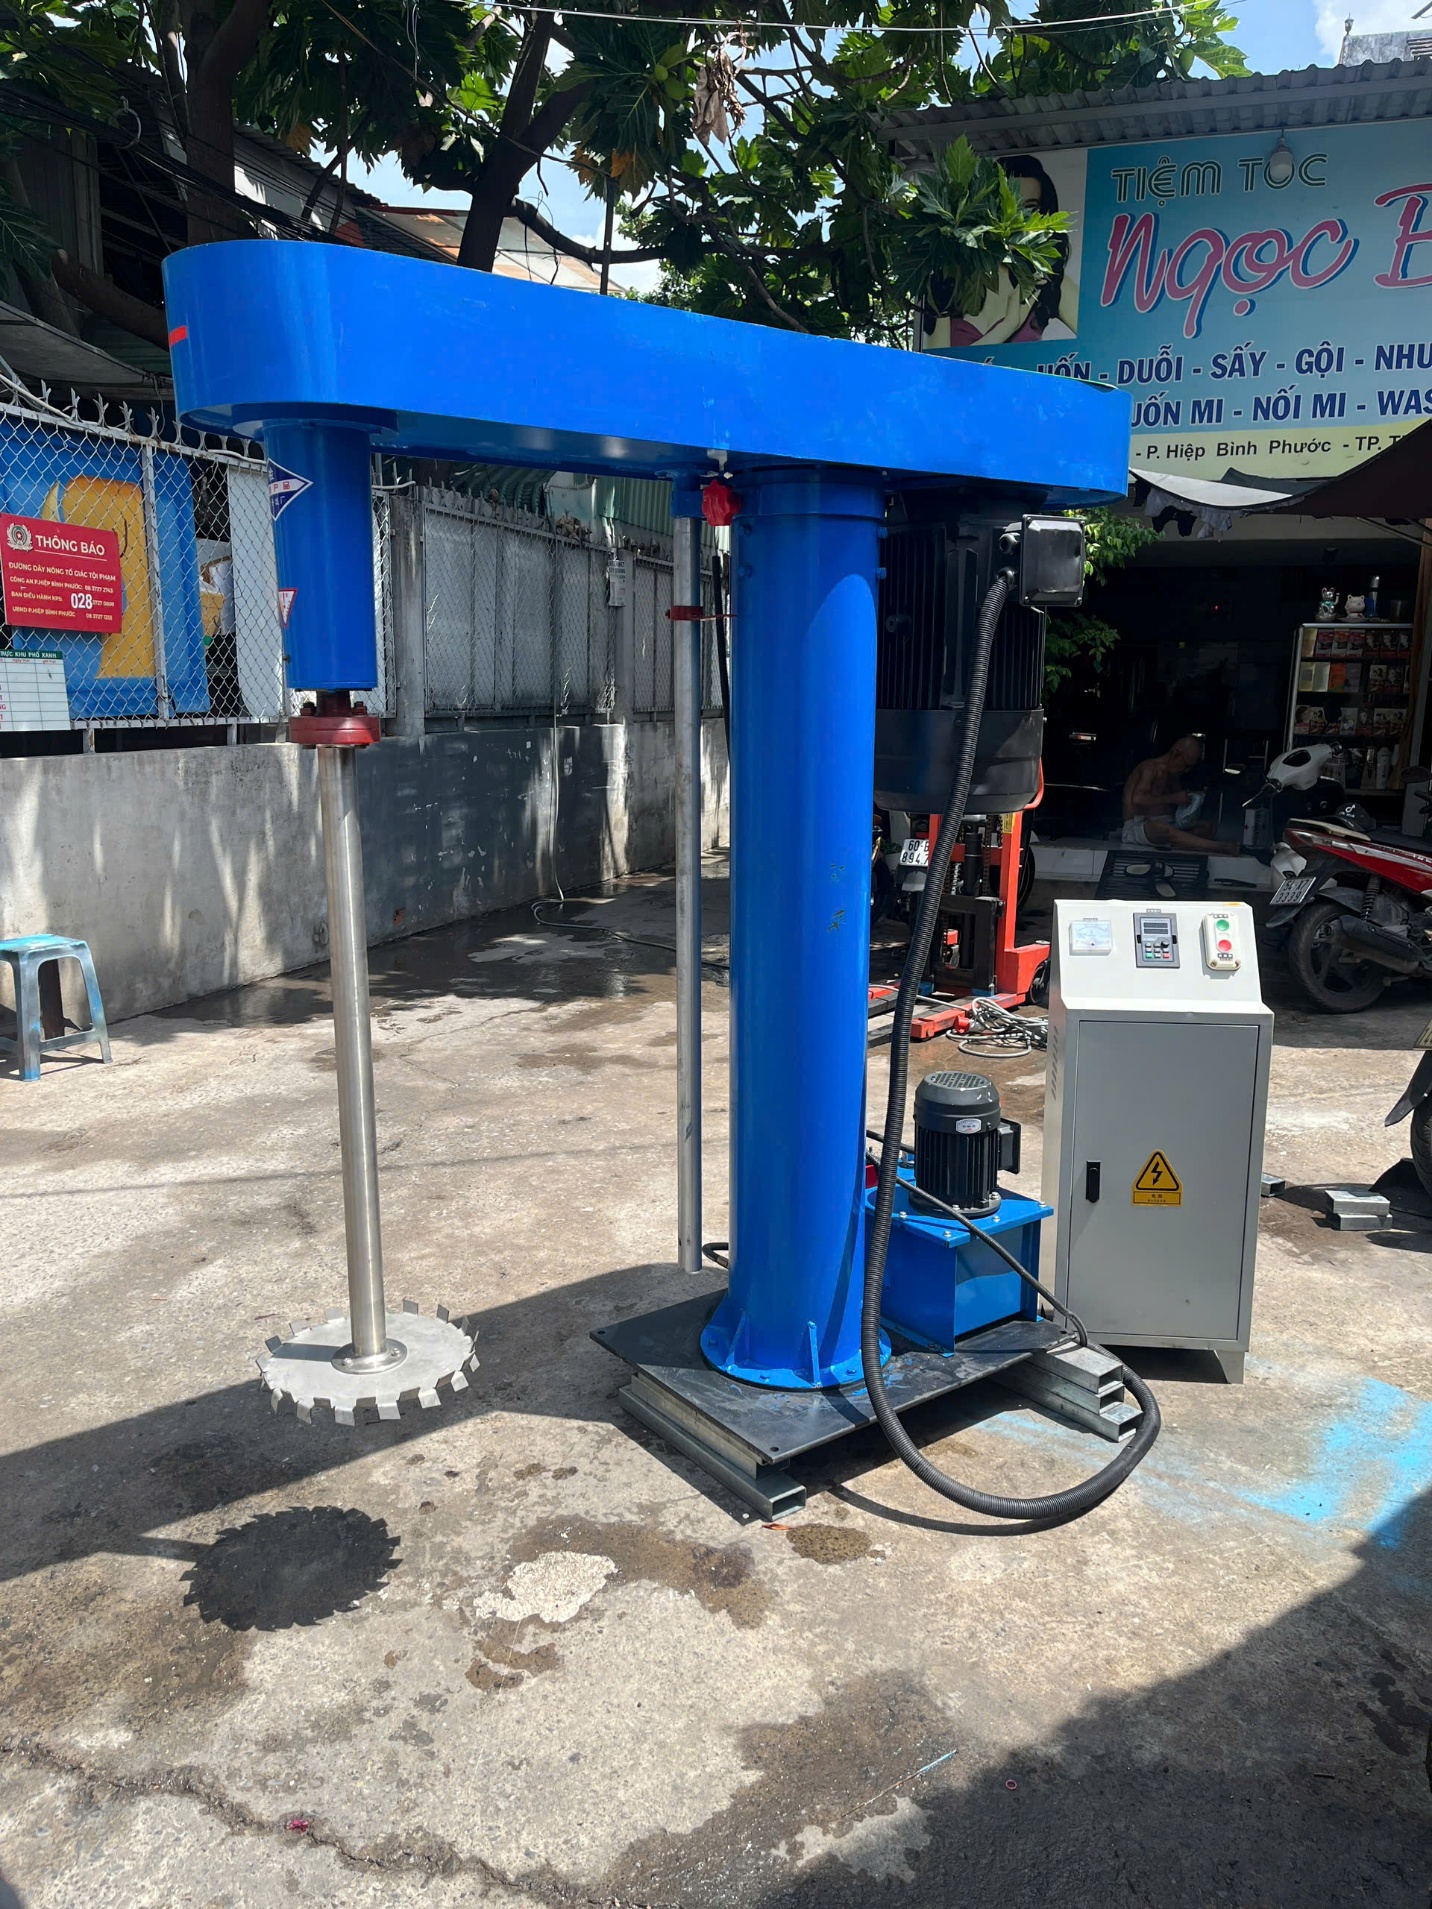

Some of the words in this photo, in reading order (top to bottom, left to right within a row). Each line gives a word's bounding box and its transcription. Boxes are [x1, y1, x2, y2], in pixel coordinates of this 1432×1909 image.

[1111, 156, 1222, 207] TIỆM
[1117, 344, 1183, 385] DUỖI
[1210, 341, 1268, 380] SẤY
[1295, 340, 1345, 379] GỘI
[1190, 398, 1224, 425] MI
[1252, 384, 1302, 422] NỐI
[1311, 392, 1347, 419] MI
[1146, 445, 1160, 460] P.
[1166, 443, 1206, 461] Hiệp
[1216, 441, 1258, 457] Bình
[1269, 438, 1331, 455] Phước
[1355, 435, 1382, 450] TP.
[35, 535, 78, 551] THÔNG
[80, 541, 105, 556] BÁO
[71, 592, 93, 610] 028
